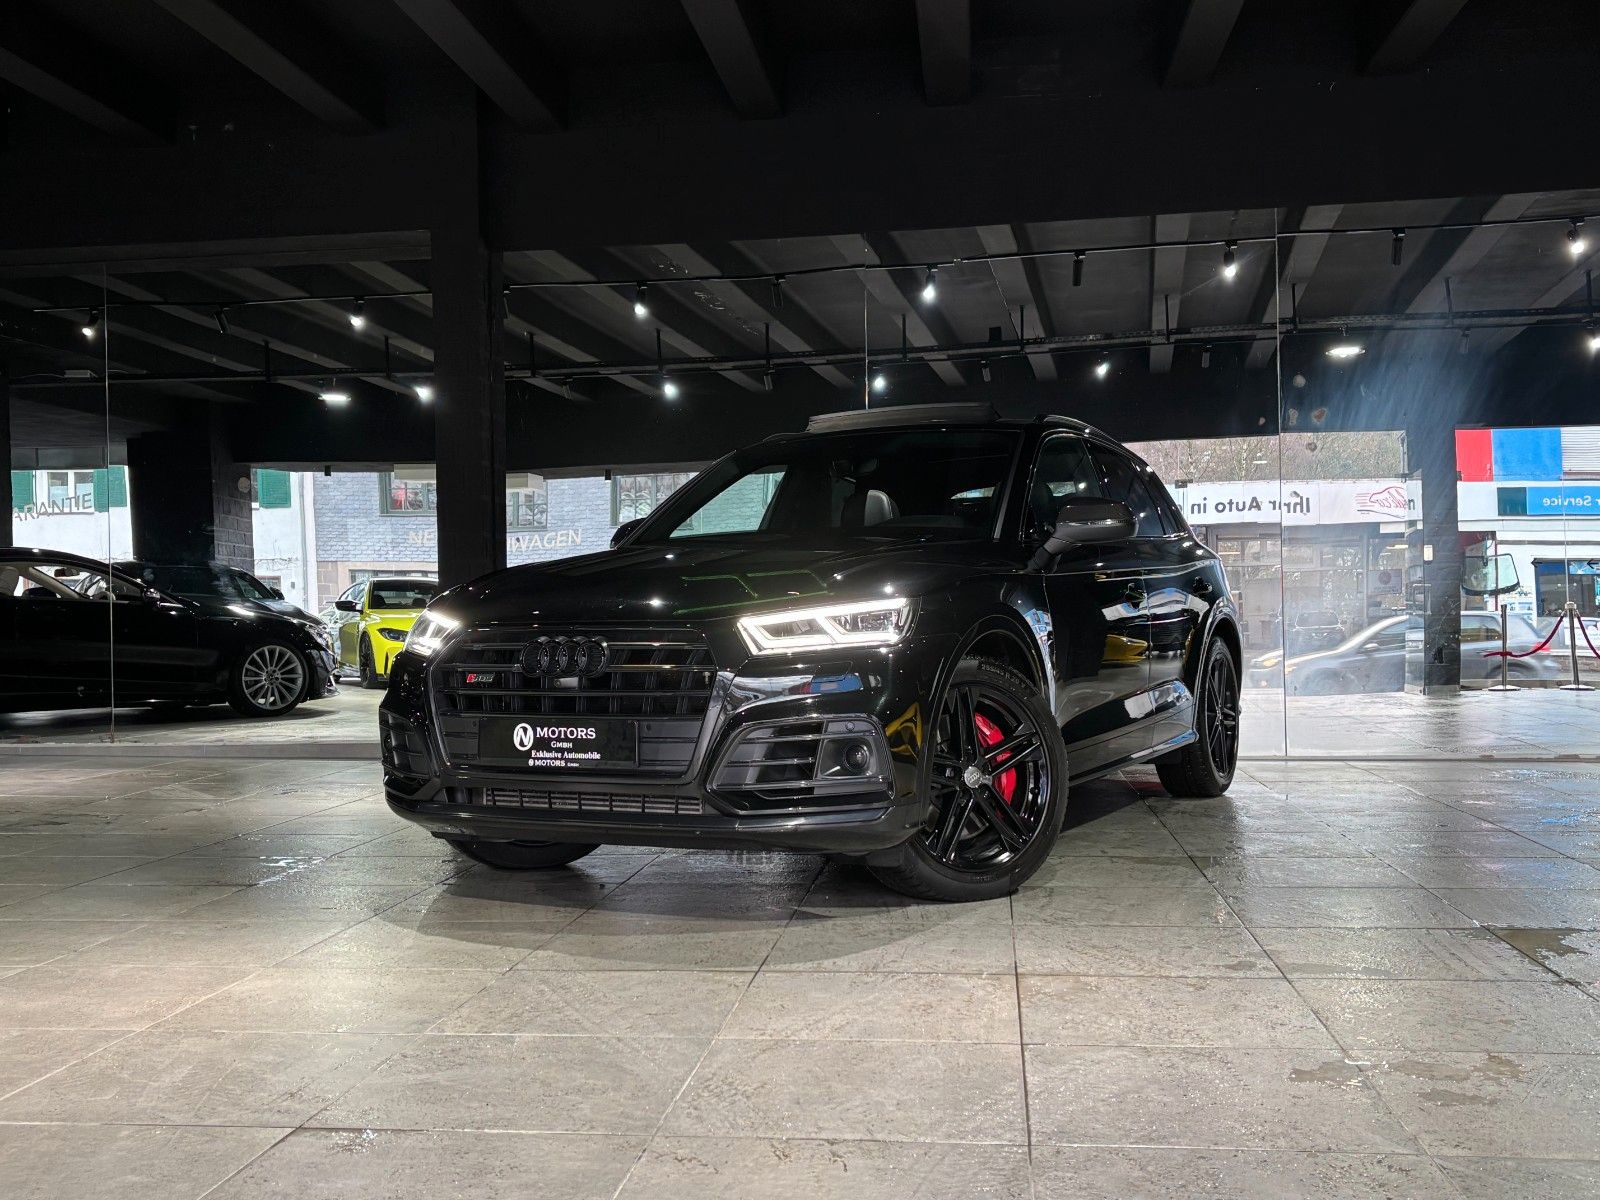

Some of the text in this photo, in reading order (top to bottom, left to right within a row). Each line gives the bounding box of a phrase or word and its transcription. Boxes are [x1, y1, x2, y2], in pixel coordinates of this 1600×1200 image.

[12, 493, 92, 522] ARANTIE
[507, 528, 583, 553] WAGEN
[535, 726, 597, 739] MOTORS
[531, 749, 602, 760] Exklusive Automobile
[534, 759, 566, 767] MOTORS
